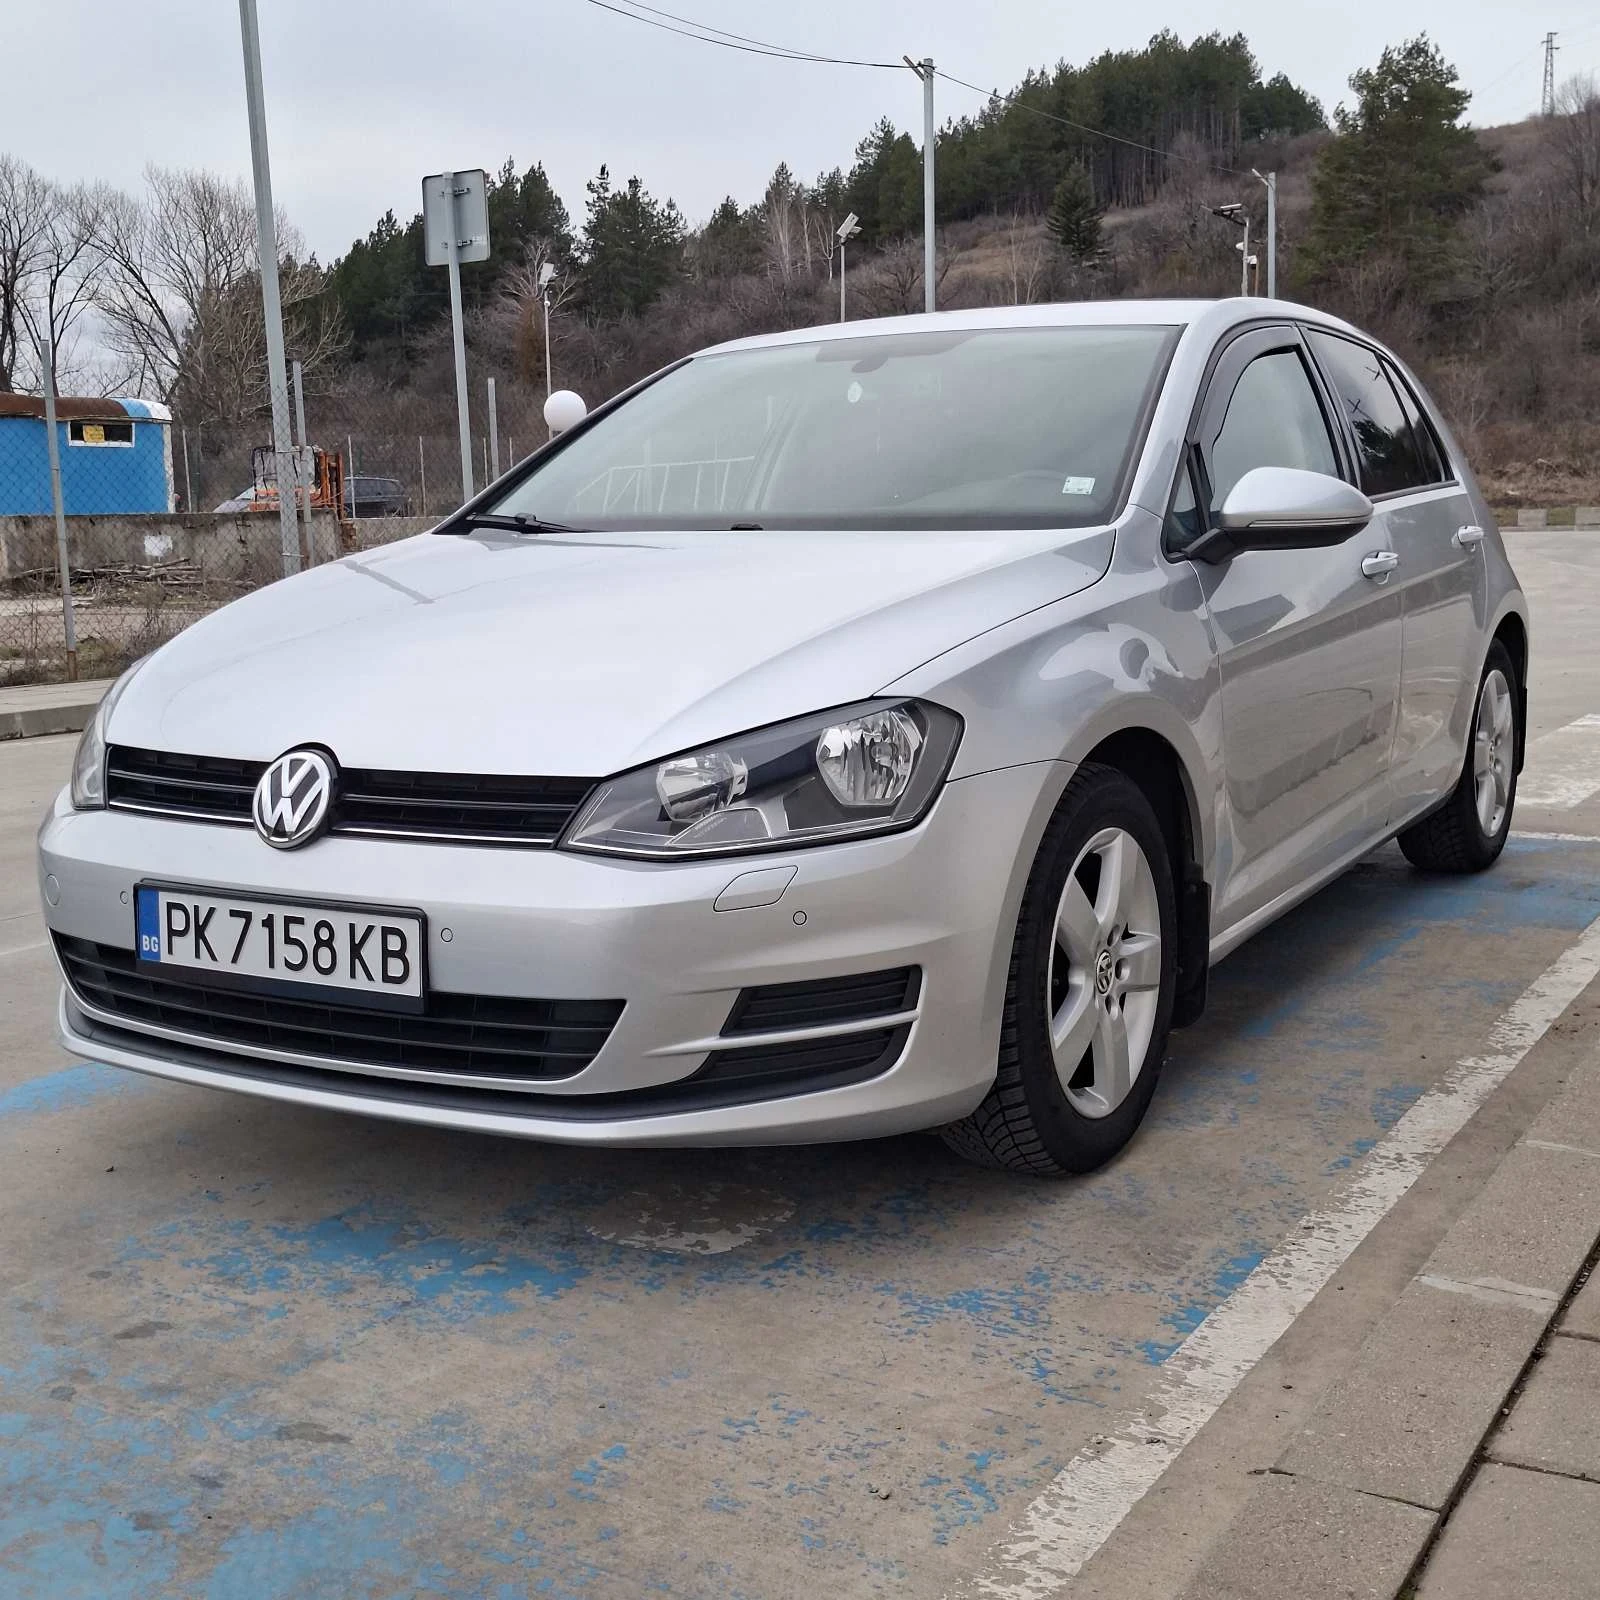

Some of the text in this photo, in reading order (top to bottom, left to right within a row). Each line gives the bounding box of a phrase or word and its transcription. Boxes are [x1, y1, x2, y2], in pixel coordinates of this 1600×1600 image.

[258, 755, 325, 836] VW
[142, 934, 159, 953] BG
[166, 901, 411, 985] PK 7158 KB
